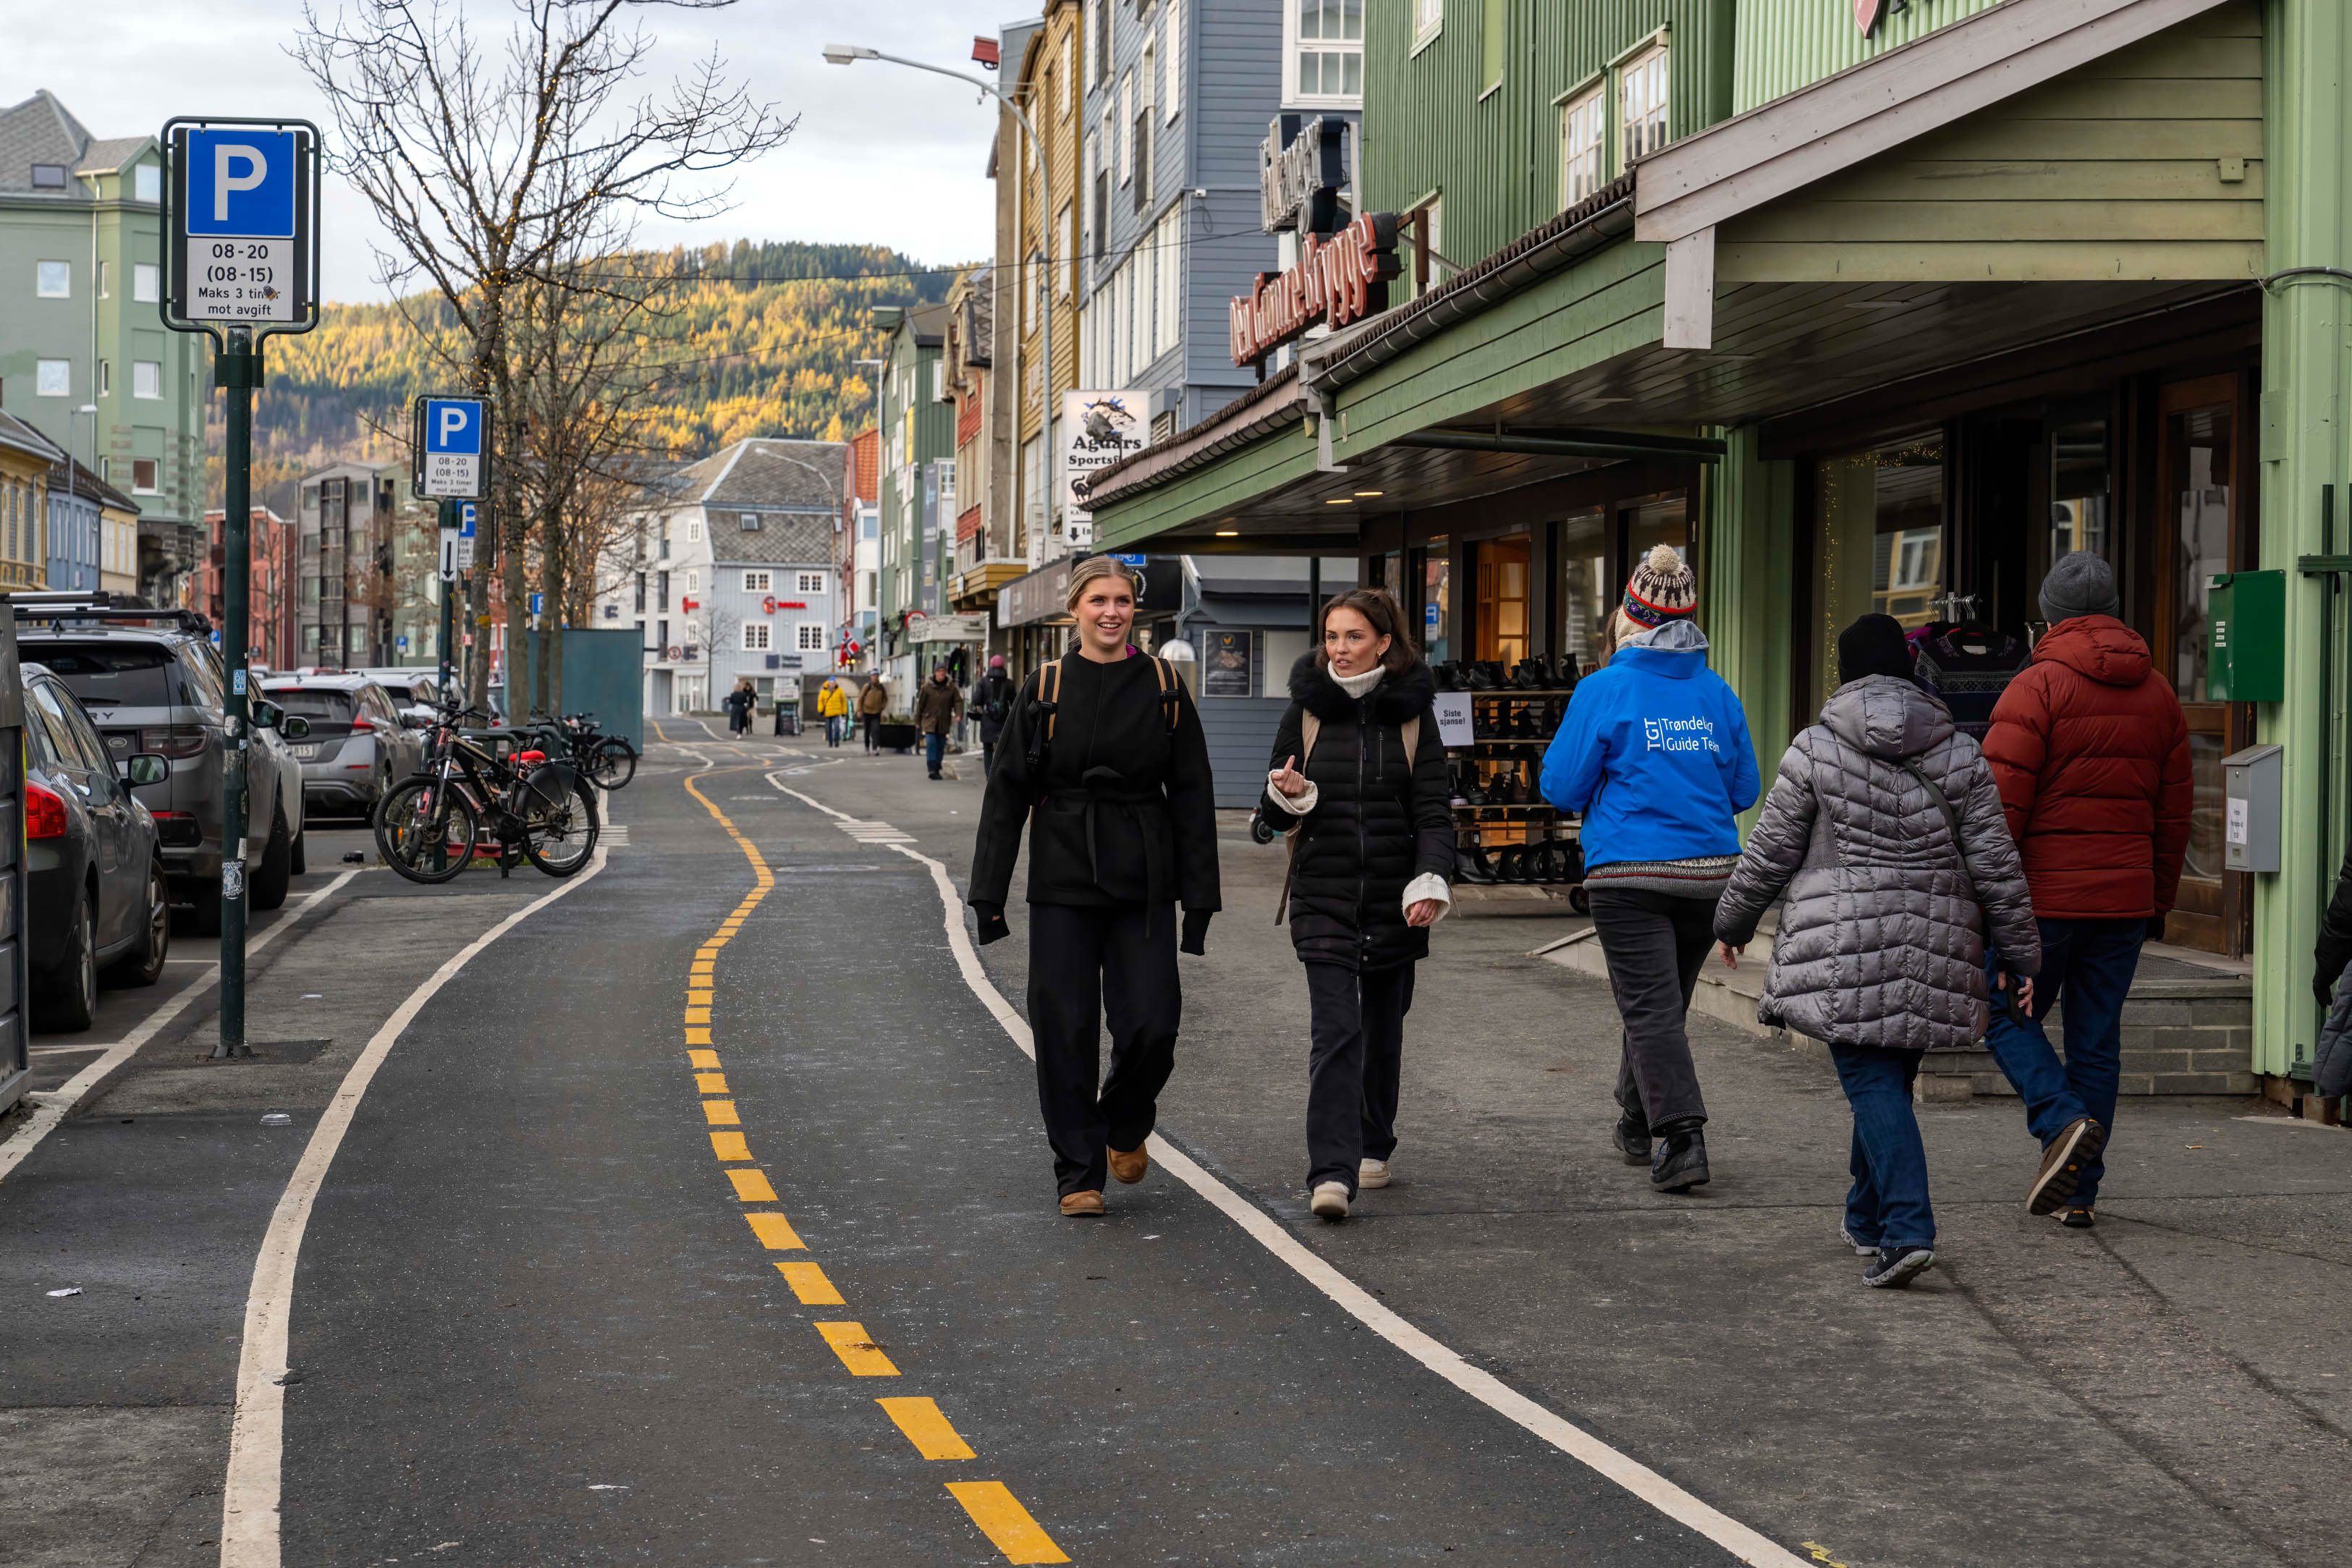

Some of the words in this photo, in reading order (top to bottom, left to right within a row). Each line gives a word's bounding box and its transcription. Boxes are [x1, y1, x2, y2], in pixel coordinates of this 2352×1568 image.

[214, 144, 268, 221] P
[198, 287, 229, 298] Maks
[236, 288, 242, 299] 3
[208, 304, 231, 314] mot
[237, 305, 271, 317] avgift
[440, 407, 468, 446] P
[1440, 717, 1465, 726] sjanse!
[1644, 718, 1661, 751] TGT
[1667, 737, 1699, 751] Guide
